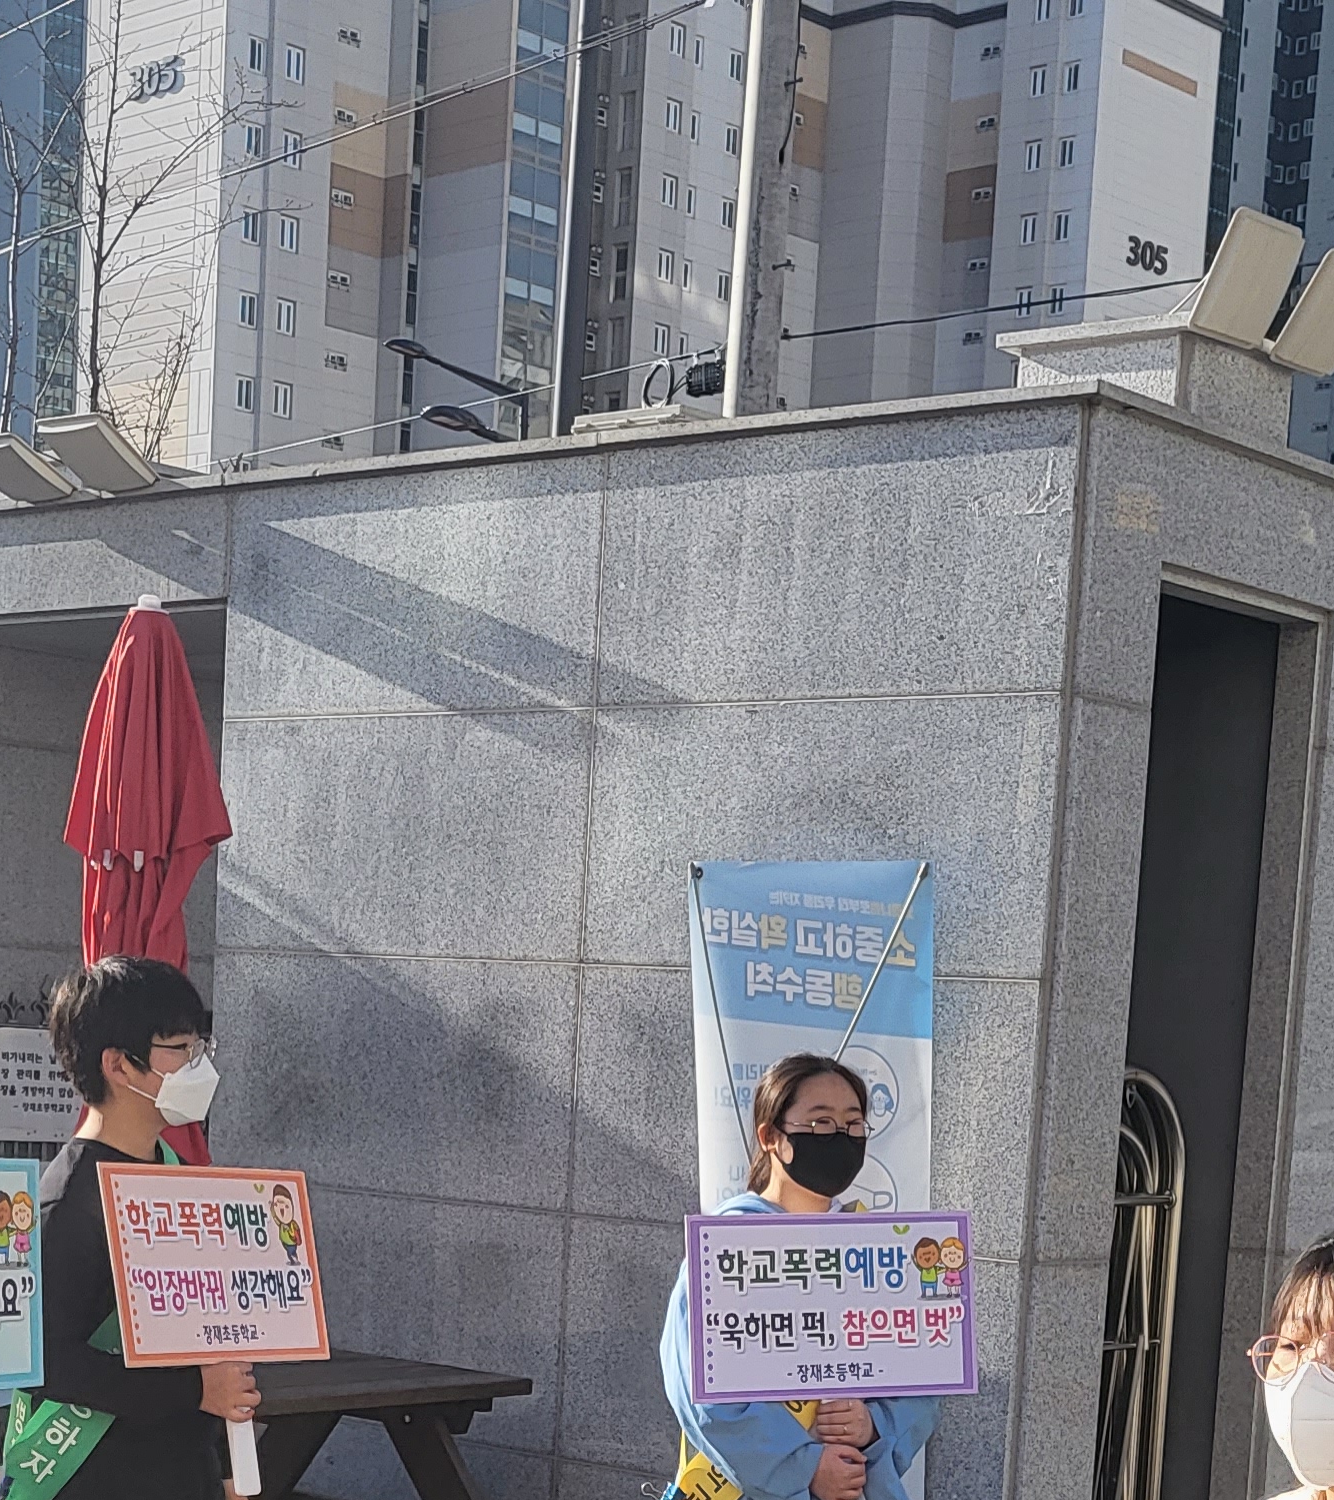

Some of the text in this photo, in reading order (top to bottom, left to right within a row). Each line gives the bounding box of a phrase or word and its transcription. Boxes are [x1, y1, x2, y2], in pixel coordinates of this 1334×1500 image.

[128, 54, 186, 103] 305
[1125, 235, 1169, 276] 305
[125, 1198, 269, 1250] 학교폭력예방
[716, 1246, 908, 1293] 학교폭력예방
[202, 1325, 259, 1345] 장재초등학교
[842, 1307, 917, 1348] 참으면
[796, 1362, 875, 1383] 장재초등학교
